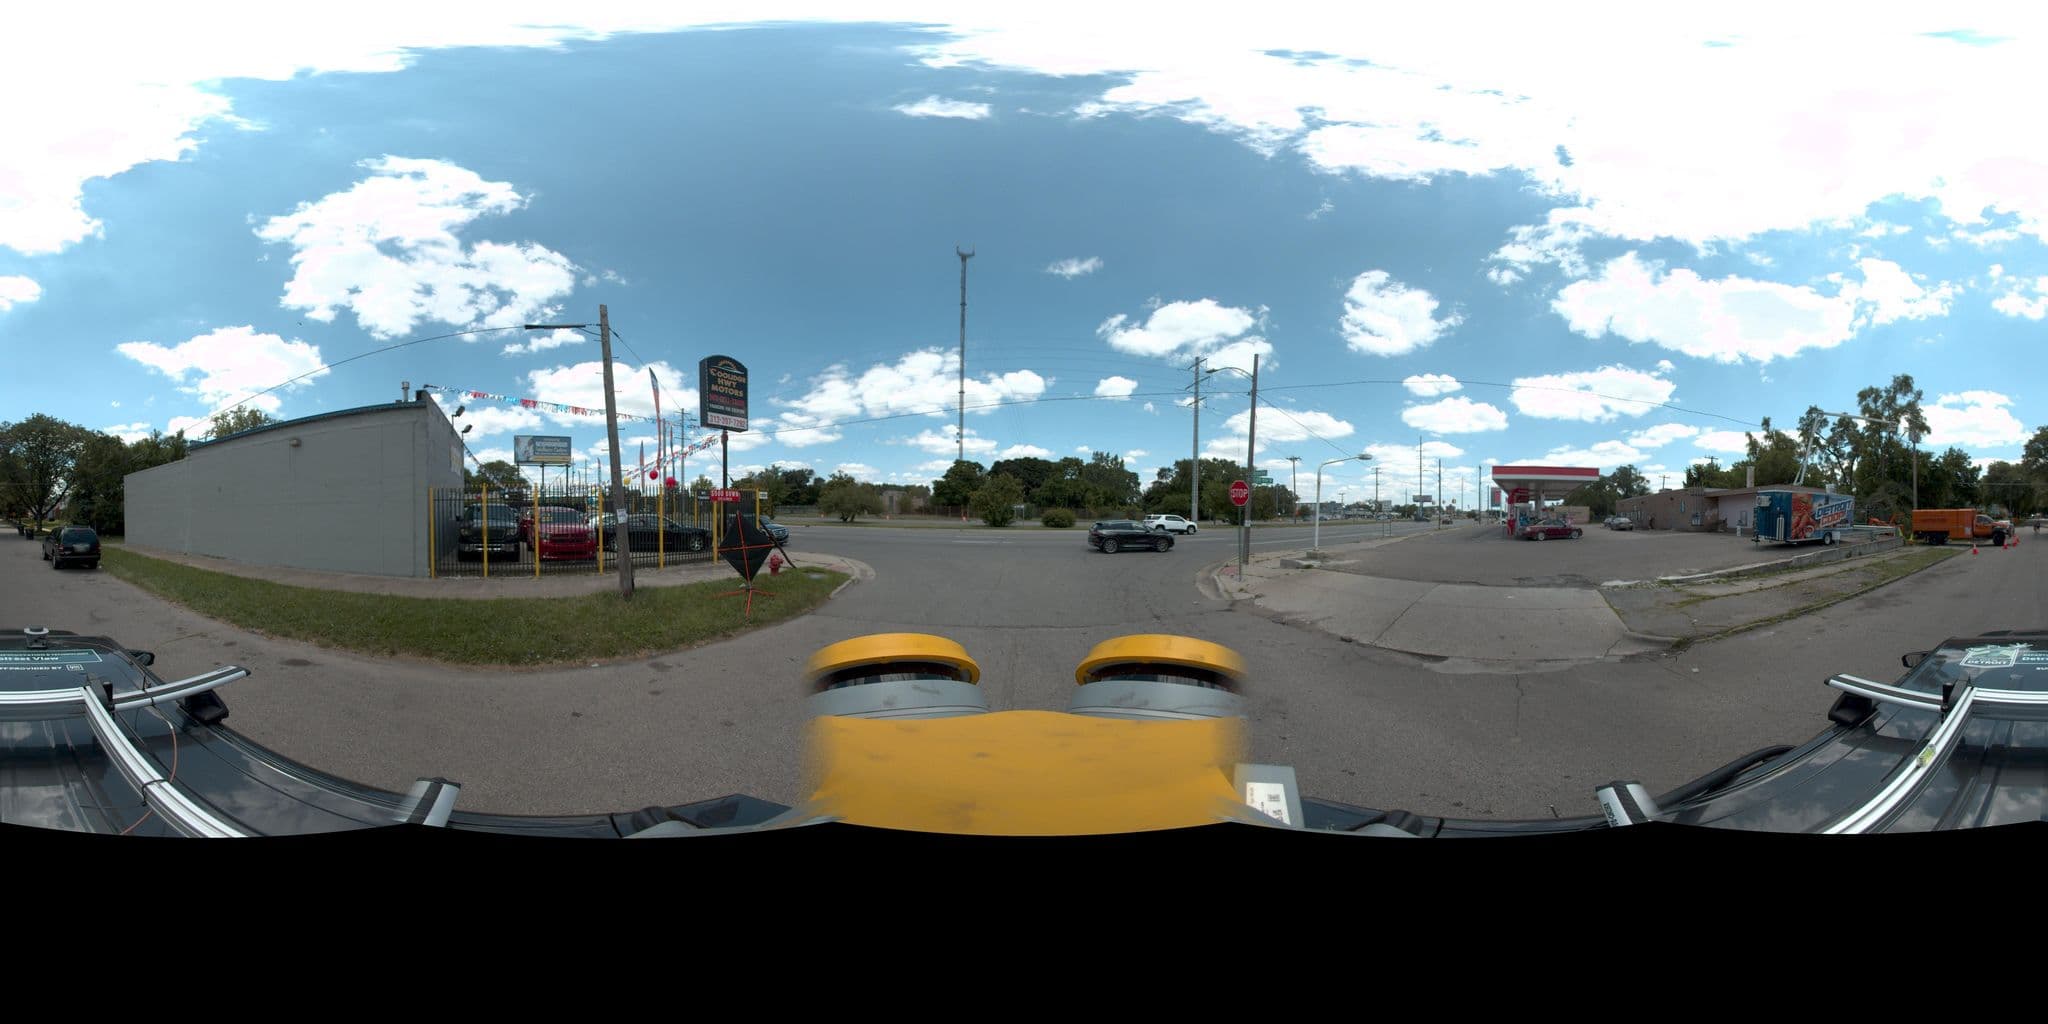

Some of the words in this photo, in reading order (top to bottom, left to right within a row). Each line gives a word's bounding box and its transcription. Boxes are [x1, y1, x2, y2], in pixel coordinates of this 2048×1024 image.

[717, 378, 737, 388] HWY
[711, 384, 744, 397] MOTORS
[1231, 488, 1248, 498] STOP
